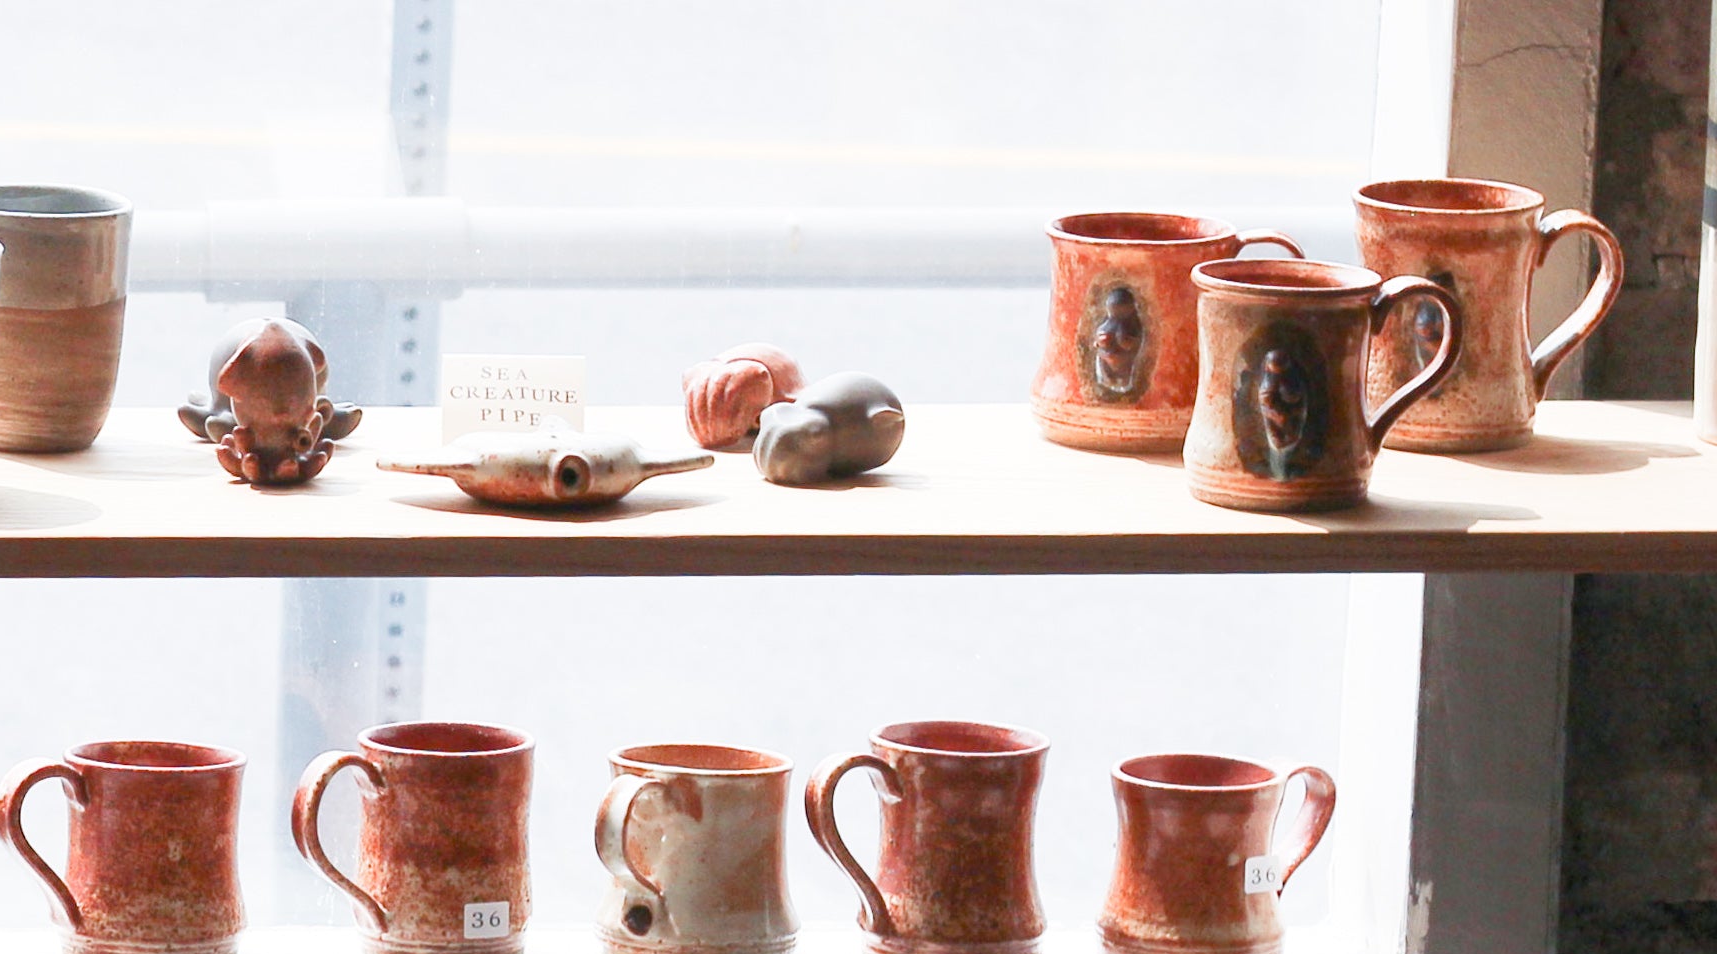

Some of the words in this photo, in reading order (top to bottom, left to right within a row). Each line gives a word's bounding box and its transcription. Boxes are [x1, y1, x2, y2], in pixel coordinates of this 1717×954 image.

[480, 366, 530, 381] SEA
[450, 385, 578, 404] CREATURE
[481, 408, 541, 426] PIPE
[1251, 866, 1276, 885] 36
[471, 910, 501, 929] 36
